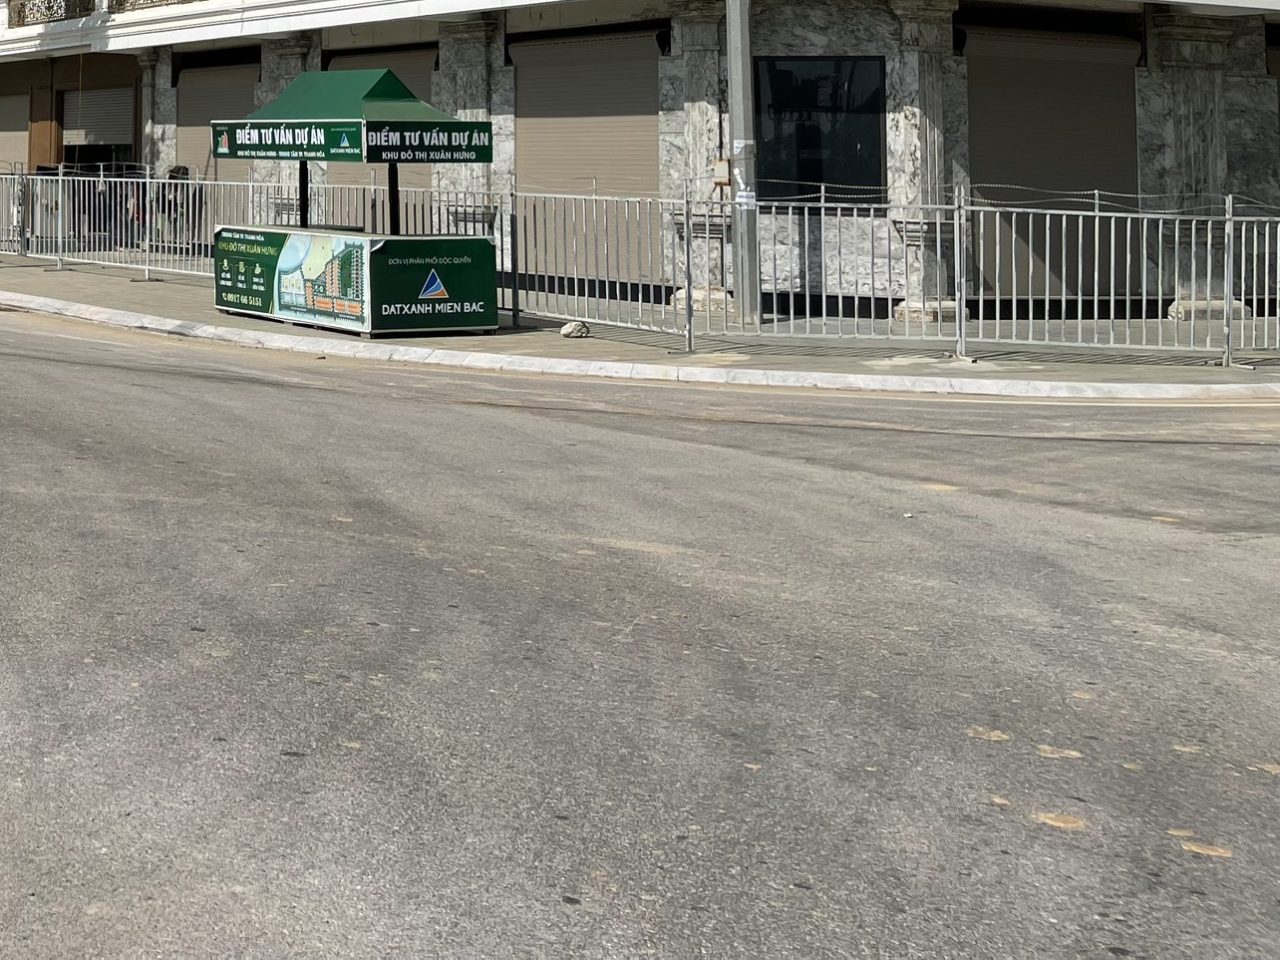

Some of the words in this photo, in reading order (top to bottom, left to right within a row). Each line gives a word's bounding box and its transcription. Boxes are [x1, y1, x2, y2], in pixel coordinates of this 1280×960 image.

[236, 123, 259, 144] ĐIỂM
[260, 127, 272, 144] TƯ
[273, 123, 293, 144] VẤN
[295, 127, 308, 148] DỰ
[310, 125, 325, 145] ÁN
[368, 126, 400, 146] ĐIỂM
[404, 130, 421, 146] TƯ
[423, 127, 448, 146] VẤN
[451, 130, 469, 149] DỰ
[471, 129, 489, 146] ÁN
[382, 151, 399, 160] KHU
[400, 149, 413, 159] ĐÔ
[414, 151, 427, 161] THỊ
[429, 149, 451, 159] XUÂN
[453, 150, 476, 160] HƯNG
[218, 241, 228, 250] KHU
[228, 241, 237, 252] ĐÔ
[246, 243, 261, 254] XUÂN
[248, 295, 262, 307] 5151
[382, 303, 433, 315] DATXANH
[435, 302, 461, 313] MIEN
[463, 301, 485, 313] BAC
